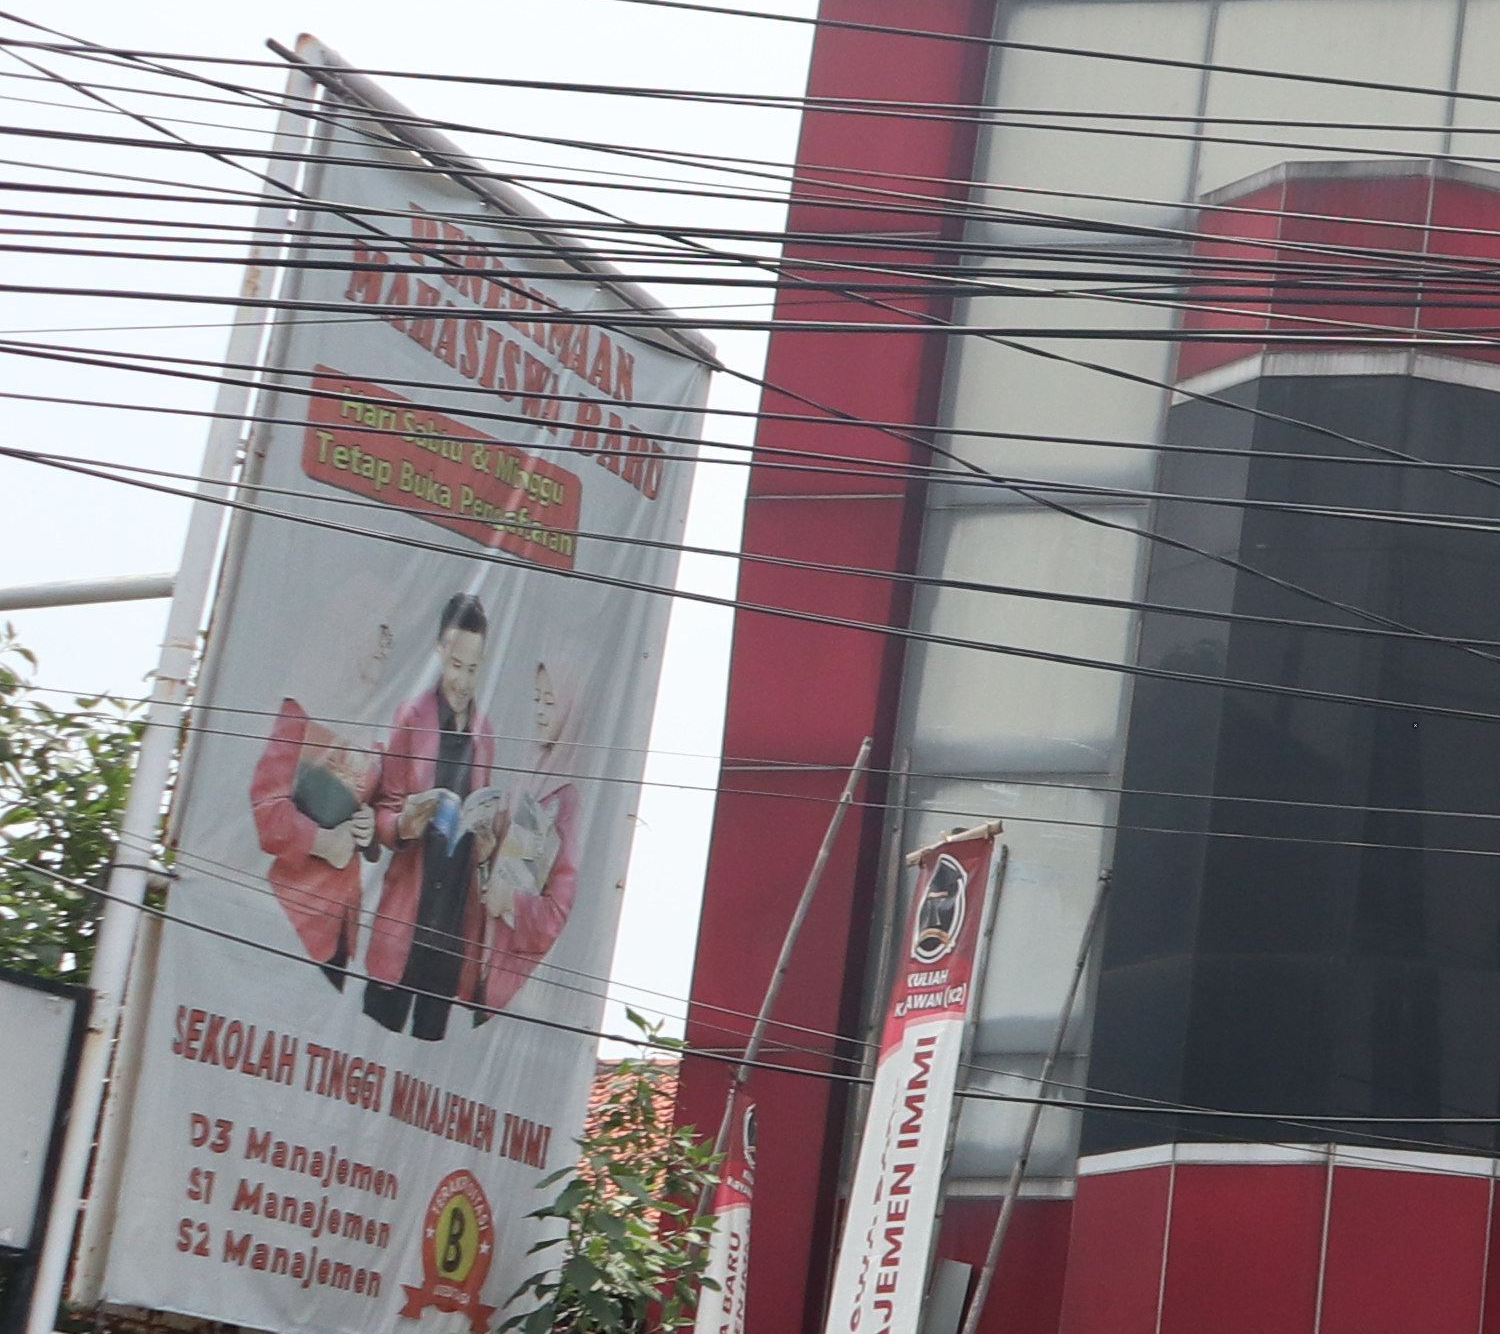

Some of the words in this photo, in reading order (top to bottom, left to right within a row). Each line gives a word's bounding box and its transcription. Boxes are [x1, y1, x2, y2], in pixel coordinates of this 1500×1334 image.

[409, 201, 636, 409] PENERIMAAN
[315, 430, 393, 487] Tetap
[399, 466, 453, 509] Buka
[341, 386, 398, 430] Hari
[402, 411, 463, 464] Sabtu
[471, 441, 490, 475] &
[571, 393, 668, 501] BARU
[908, 969, 949, 988] KULIAH
[172, 1004, 298, 1086] SEKOLAH
[304, 1042, 388, 1113] TINGGI
[388, 1070, 498, 1153] MANAJEMEN
[499, 1111, 553, 1170] IMMI
[896, 1035, 938, 1149] IMMI
[189, 1113, 234, 1154] D3
[243, 1126, 400, 1201] Manajemen
[186, 1167, 215, 1204] S1
[231, 1178, 392, 1249] Manajemen
[442, 1206, 466, 1273] B
[175, 1217, 212, 1257] S2
[222, 1228, 383, 1298] Manajemen
[723, 1231, 741, 1315] BARU
